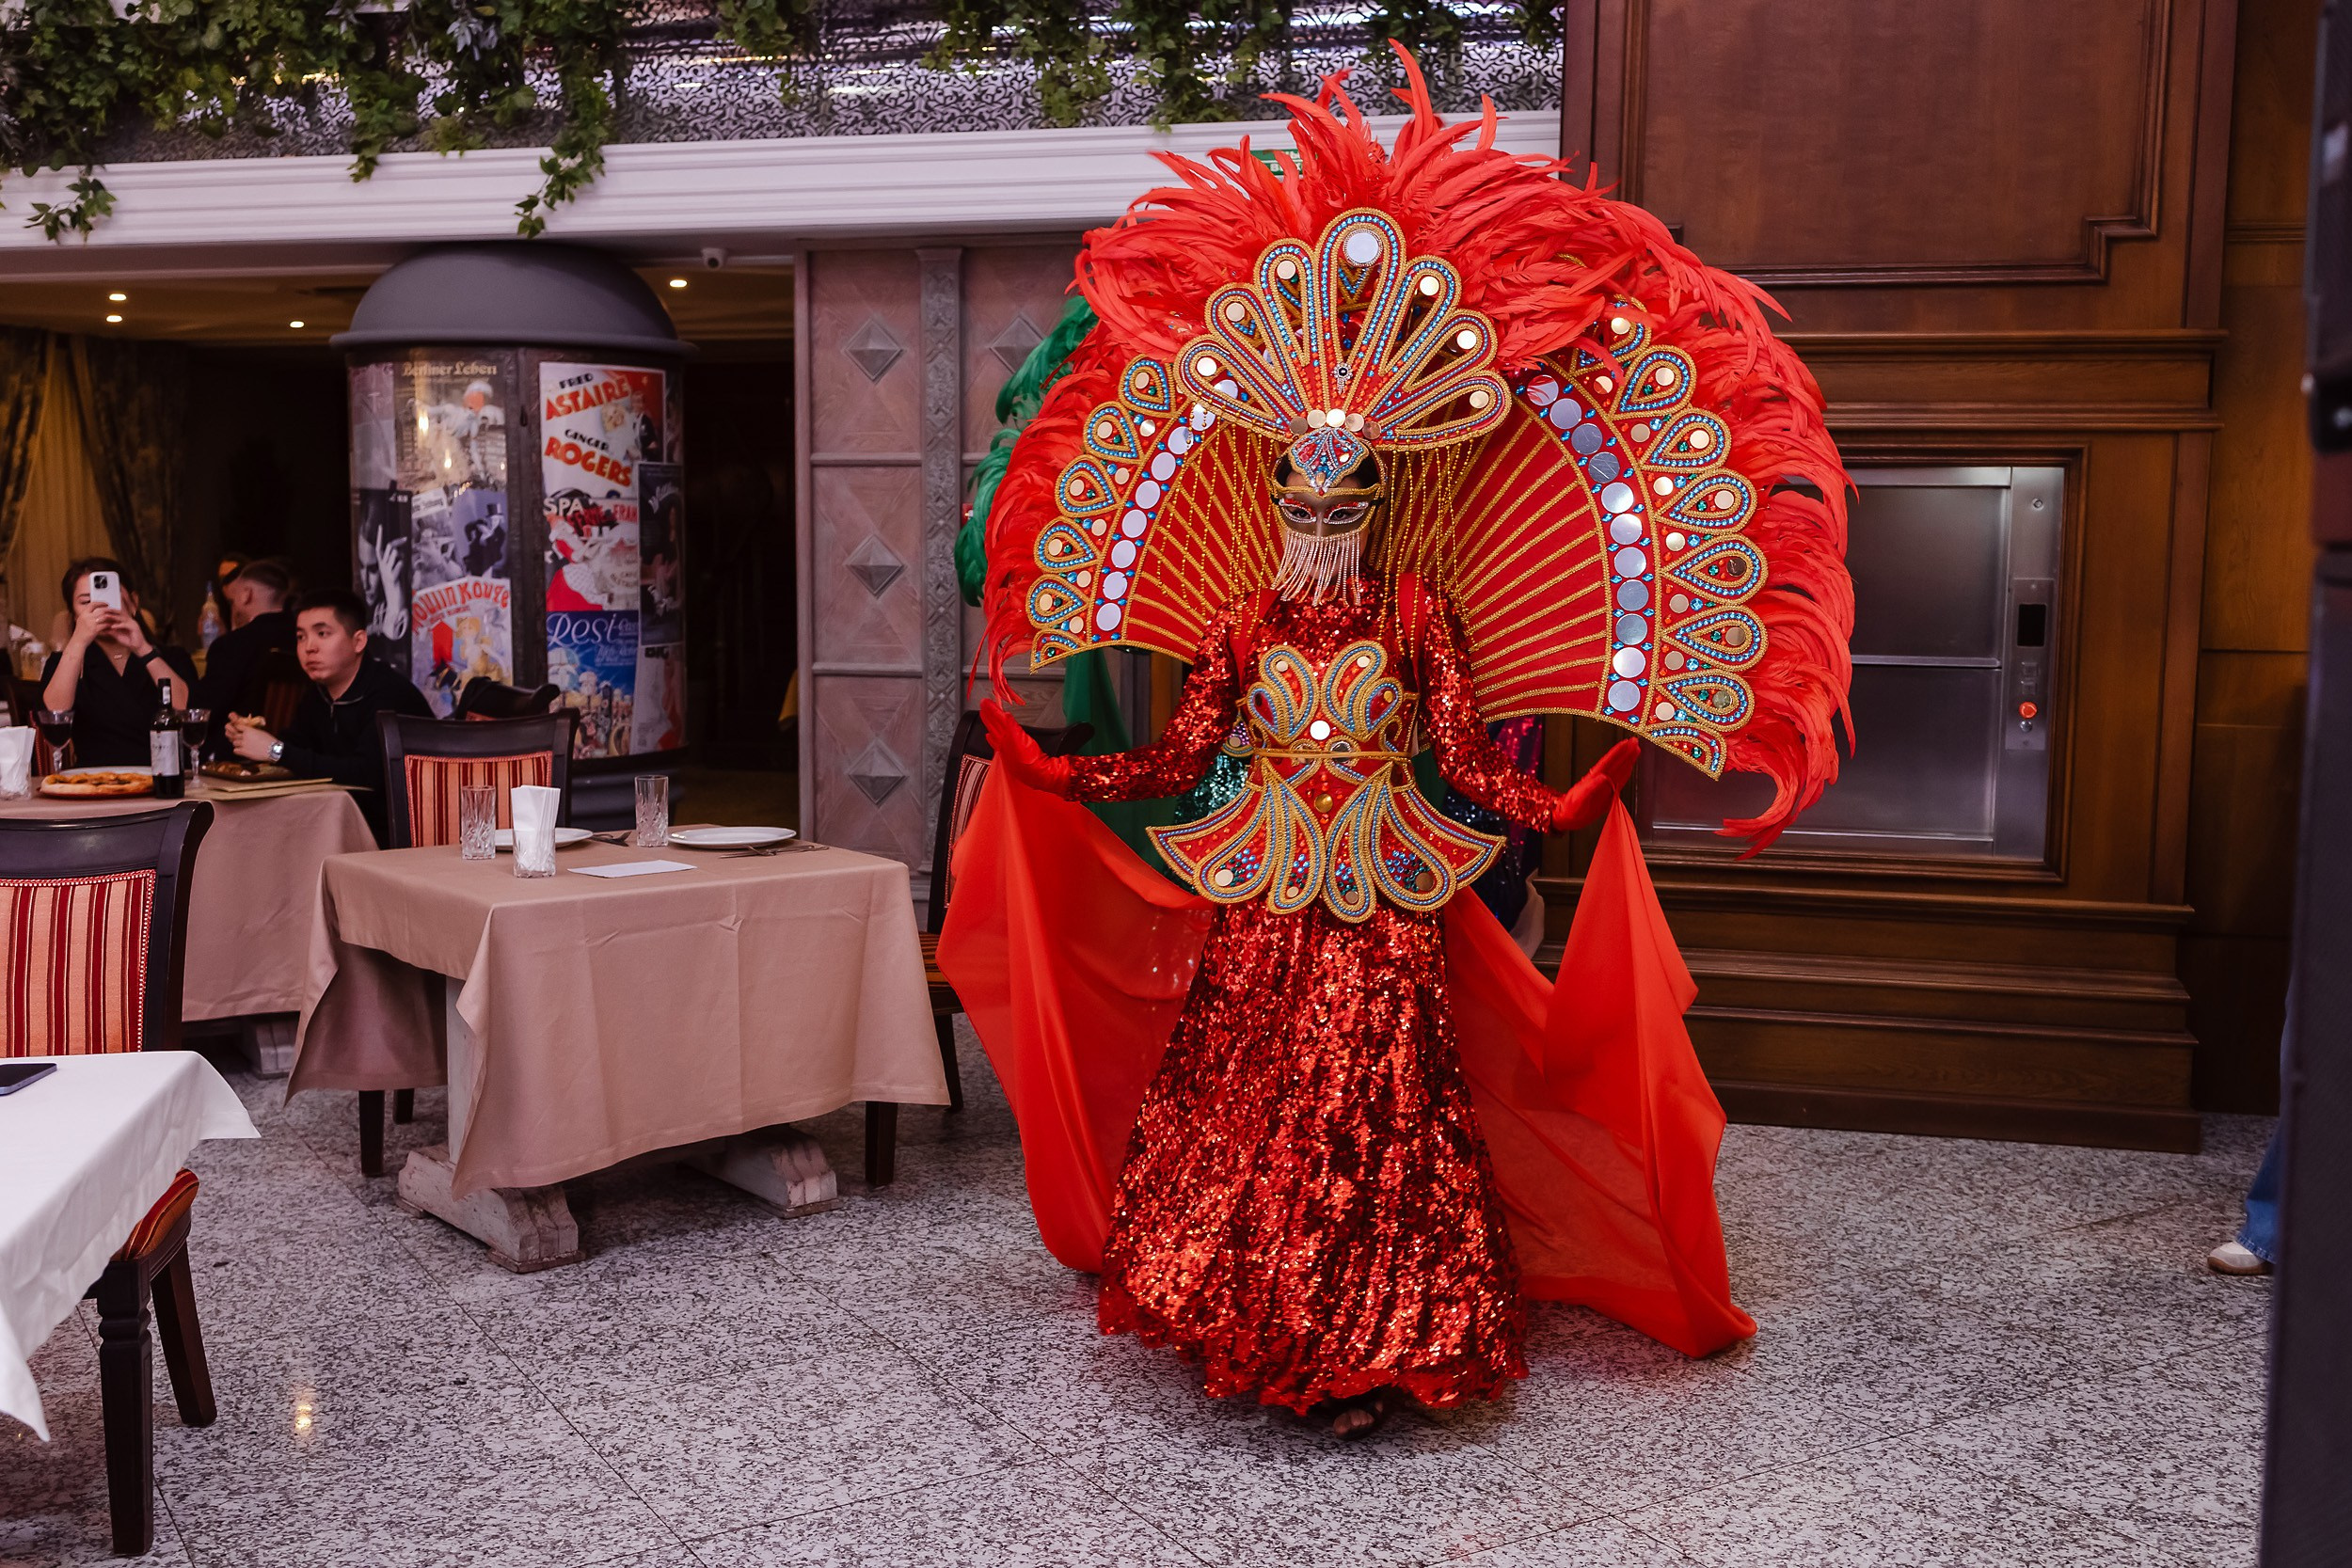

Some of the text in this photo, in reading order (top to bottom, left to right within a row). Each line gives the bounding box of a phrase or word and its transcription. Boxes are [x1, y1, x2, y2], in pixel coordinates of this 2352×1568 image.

[454, 361, 498, 375] Leben
[559, 372, 594, 389] FRED
[545, 374, 631, 421] ASTAIRE
[564, 428, 610, 451] GINGER
[544, 436, 632, 487] ROGERS
